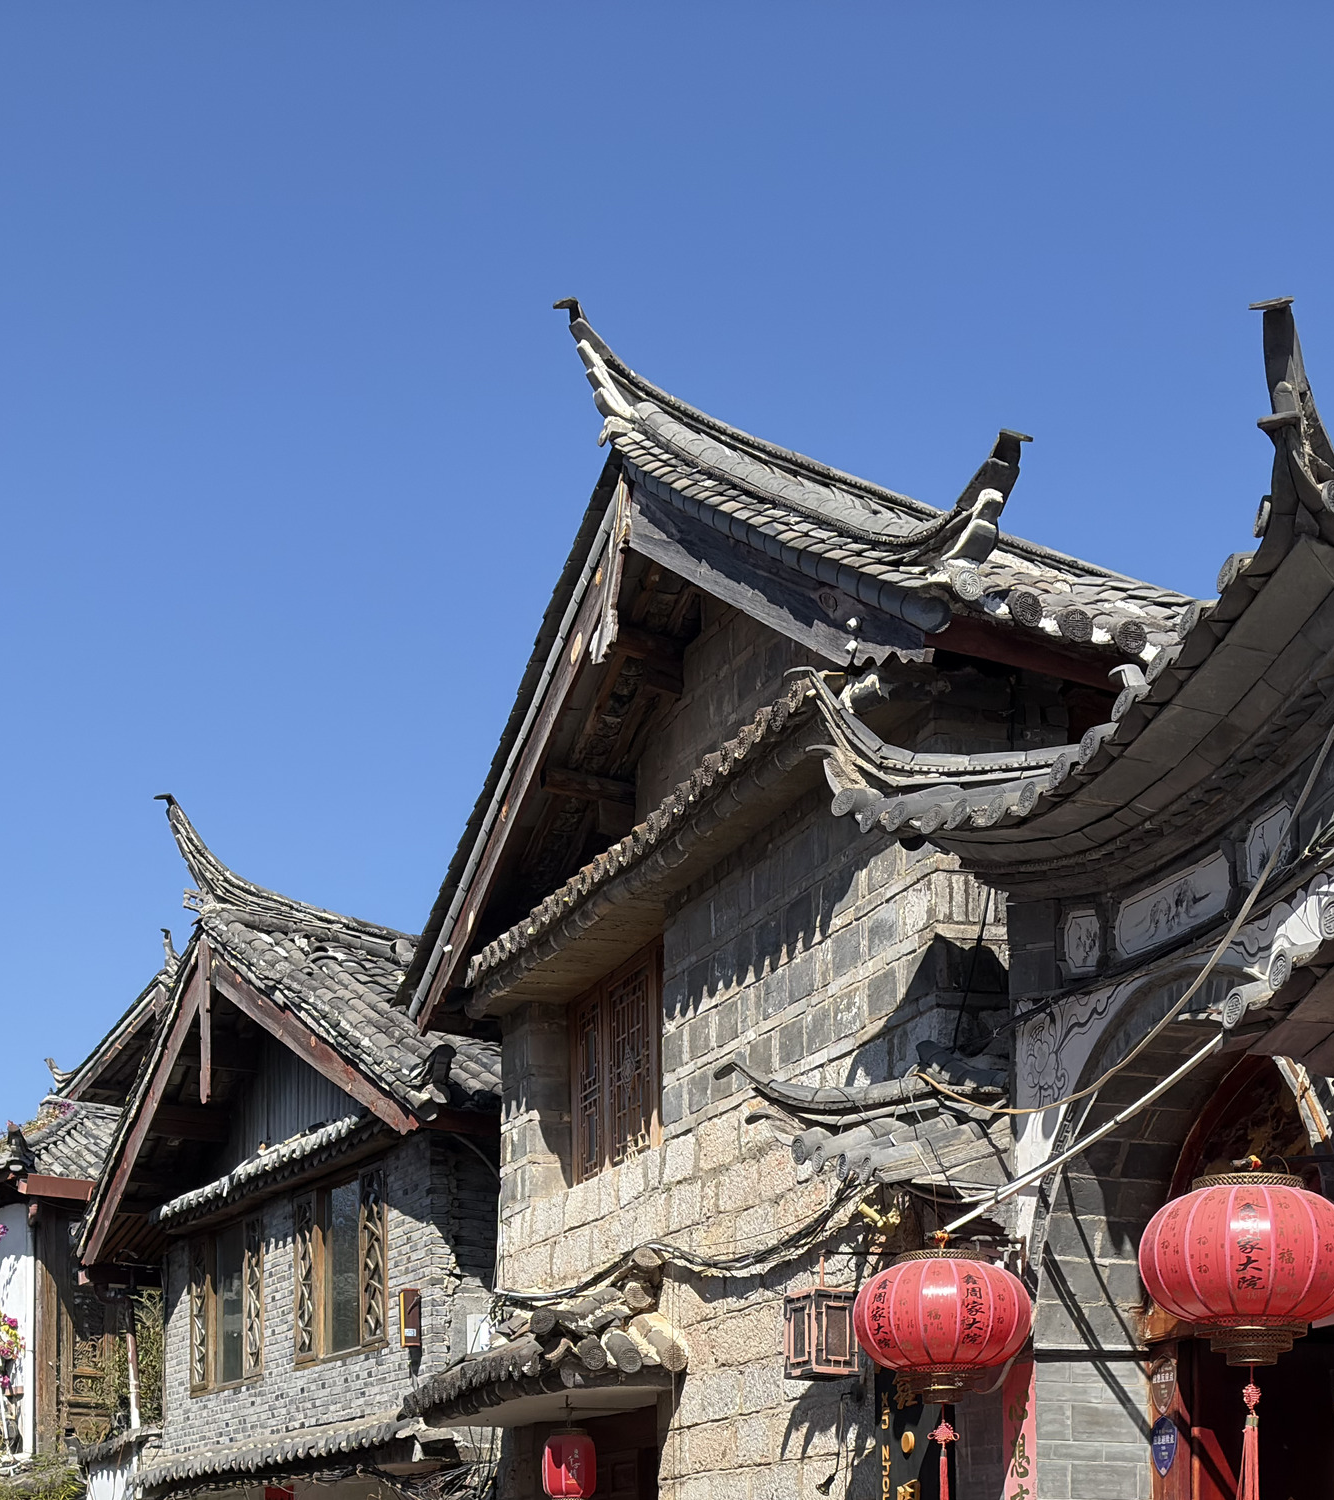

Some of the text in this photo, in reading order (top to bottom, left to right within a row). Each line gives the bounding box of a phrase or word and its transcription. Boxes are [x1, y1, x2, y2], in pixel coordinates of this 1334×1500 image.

[870, 1278, 896, 1349] 鑫周家大院
[961, 1273, 986, 1345] 鑫周家大院
